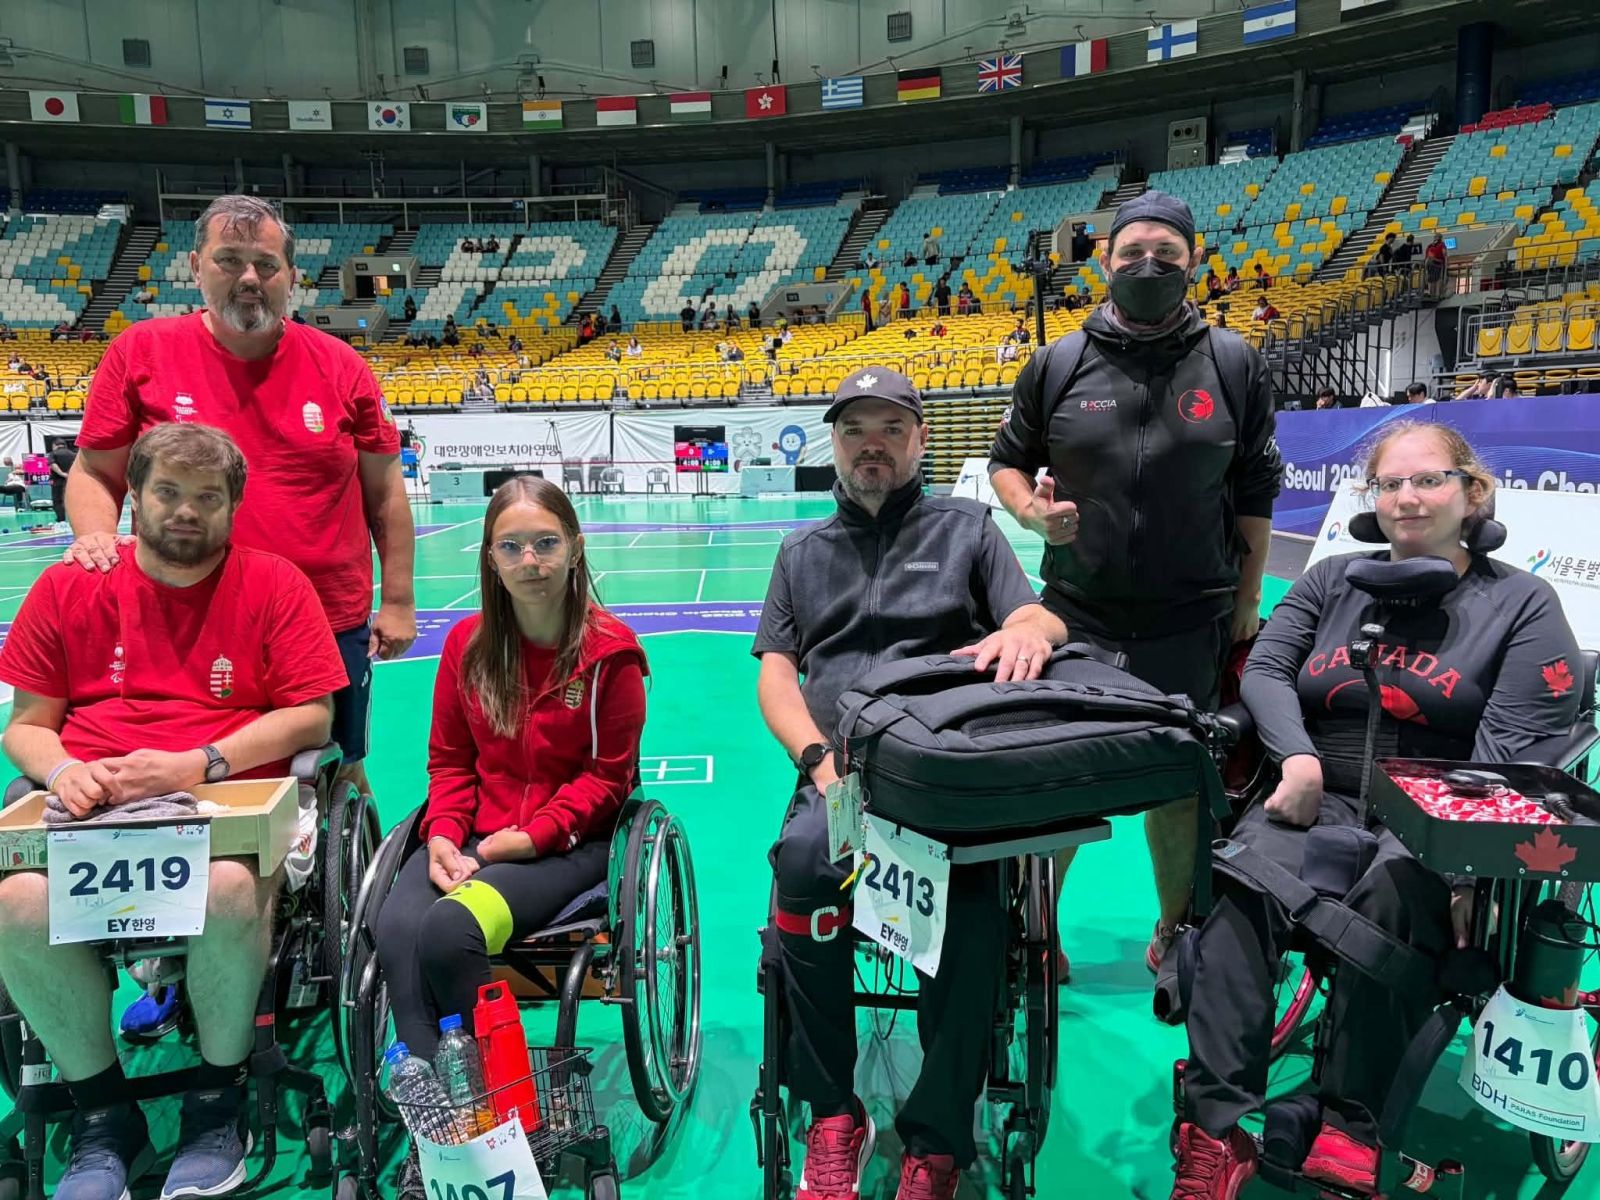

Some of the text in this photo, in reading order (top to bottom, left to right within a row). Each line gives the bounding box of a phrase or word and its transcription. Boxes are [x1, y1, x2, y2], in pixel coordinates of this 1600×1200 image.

[453, 477, 460, 486] 3
[1284, 462, 1326, 492] Seoul
[1537, 470, 1600, 495] Cha
[1547, 555, 1600, 581] 서울특별
[68, 856, 191, 897] 2419
[864, 852, 935, 917] 2413
[810, 905, 839, 942] C
[1481, 1020, 1590, 1091] 1410
[1471, 1072, 1580, 1126] BDH PARAS Foundation
